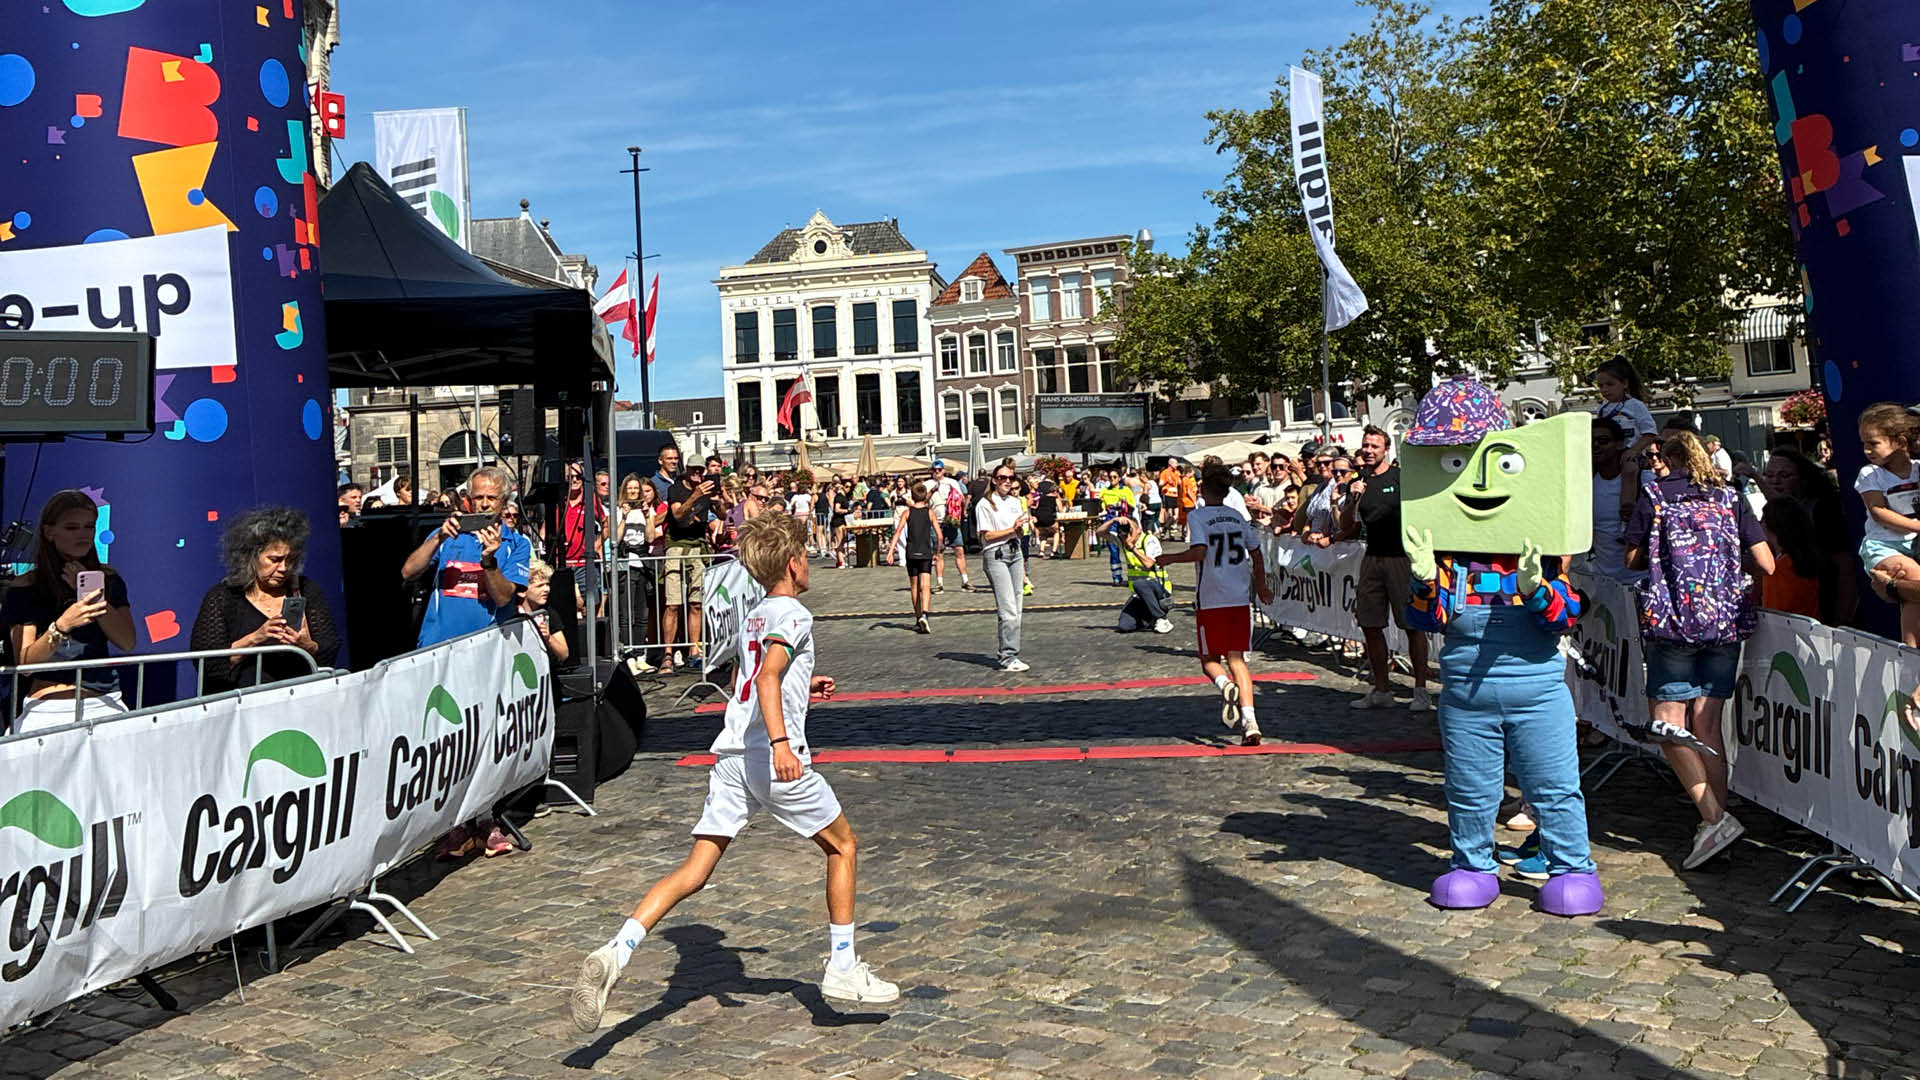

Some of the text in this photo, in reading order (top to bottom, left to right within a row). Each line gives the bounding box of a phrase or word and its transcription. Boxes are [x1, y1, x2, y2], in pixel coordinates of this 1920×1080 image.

[739, 295, 794, 308] HOTEL
[863, 287, 908, 298] ZALM
[1314, 433, 1344, 446] MNA
[1208, 531, 1244, 568] 75
[1279, 566, 1332, 613] Cargill
[740, 641, 762, 702] 7
[493, 673, 550, 764] Cargill
[1735, 673, 1832, 783] Cargill
[385, 703, 480, 820] Cargill
[127, 811, 143, 827] TM
[178, 751, 360, 898] Cargill
